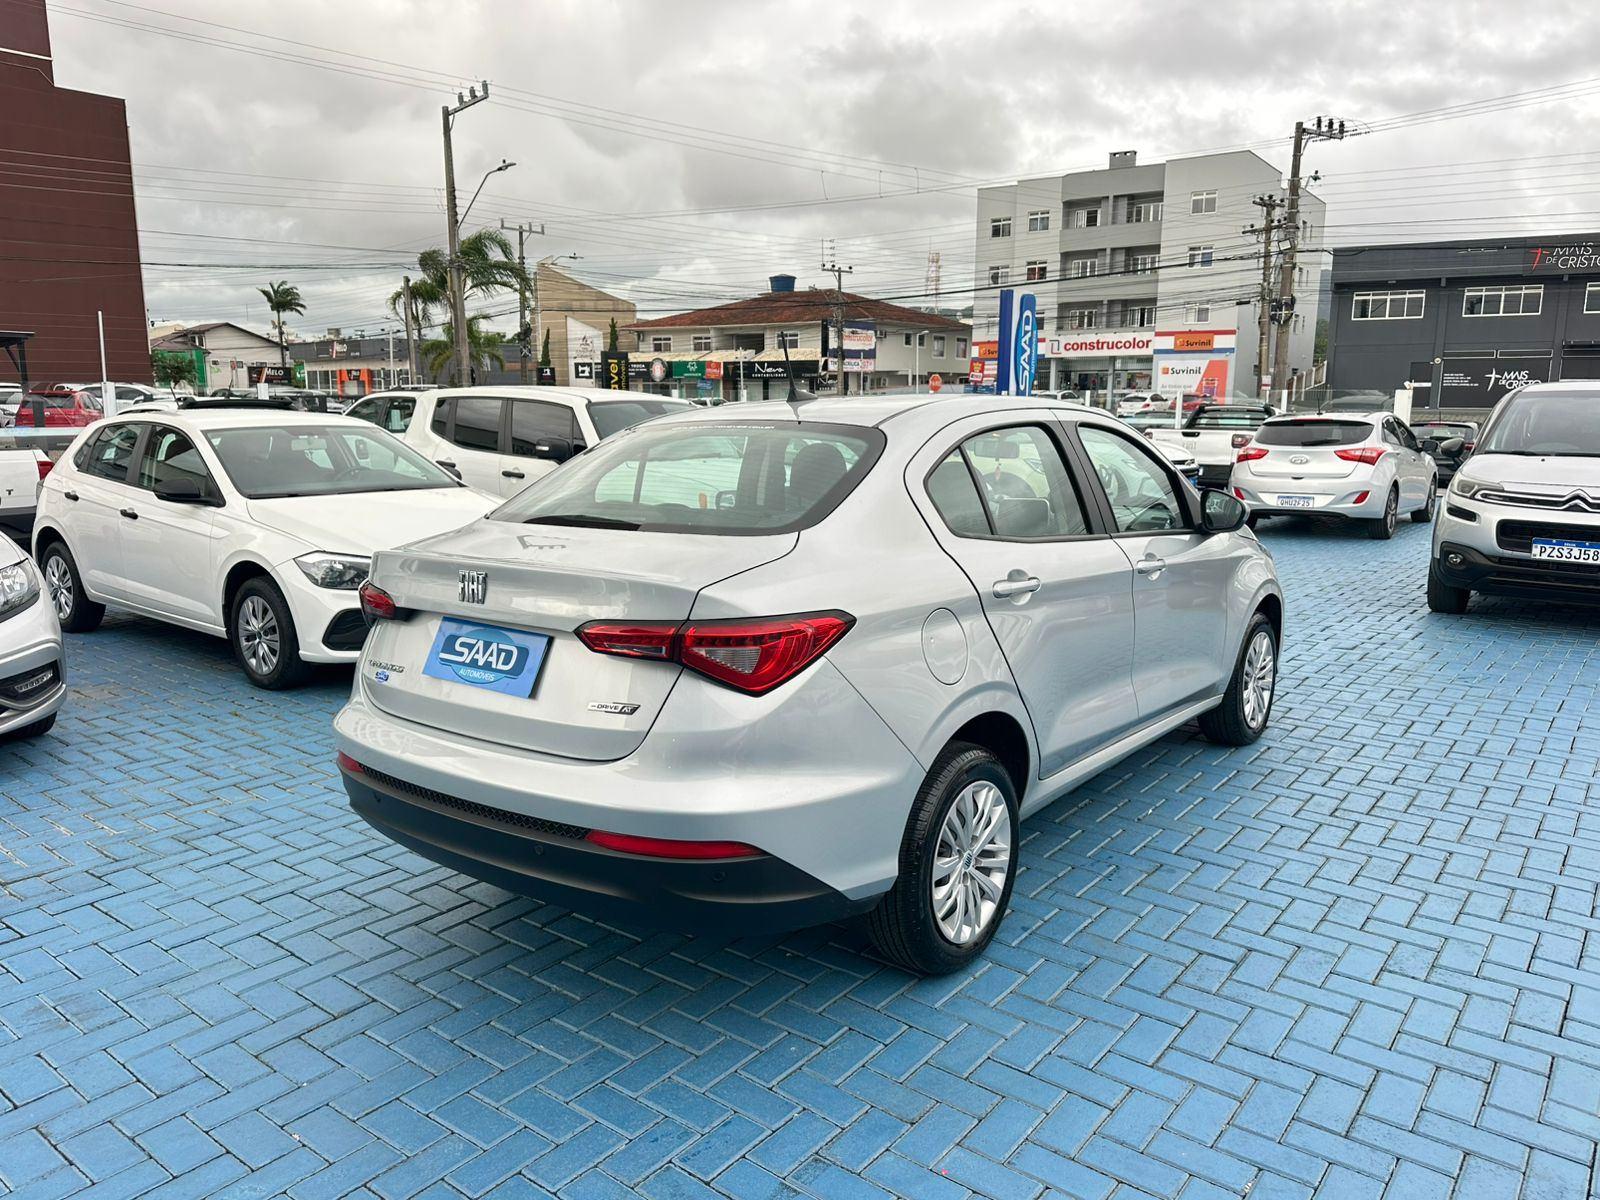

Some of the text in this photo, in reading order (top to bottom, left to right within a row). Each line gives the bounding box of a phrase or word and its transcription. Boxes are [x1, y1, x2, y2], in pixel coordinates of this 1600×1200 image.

[1553, 242, 1594, 255] MAIS
[1064, 337, 1152, 352] construcolor
[1019, 309, 1033, 396] SAAD
[1170, 366, 1202, 375] Suvinil
[1502, 370, 1529, 380] MAIS
[1538, 545, 1600, 562] PZS3J58
[458, 569, 487, 604] FIAT
[439, 636, 518, 671] SAAD
[596, 703, 620, 711] DRIVE
